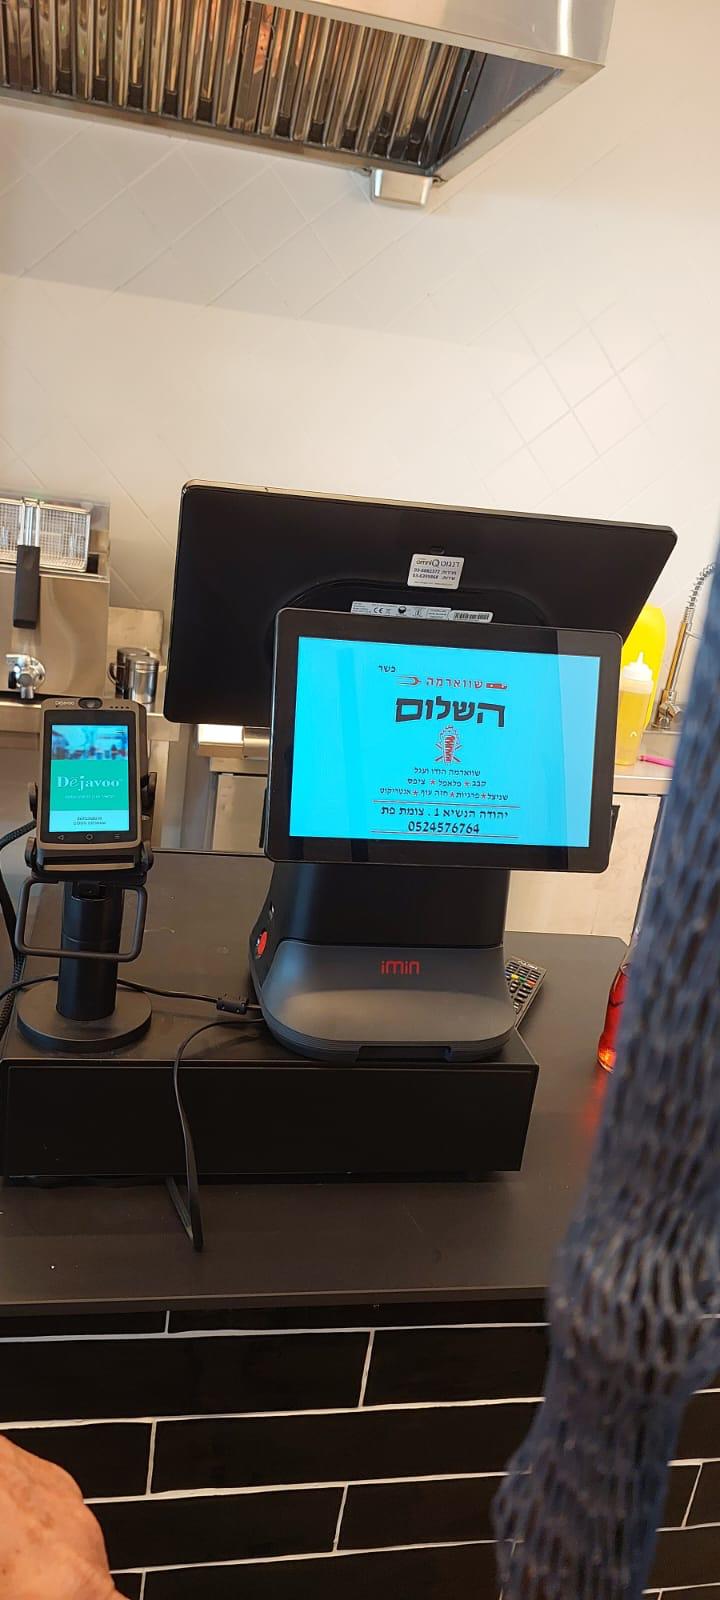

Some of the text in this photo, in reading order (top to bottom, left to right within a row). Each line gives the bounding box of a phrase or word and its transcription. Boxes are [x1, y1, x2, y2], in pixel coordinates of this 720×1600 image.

[378, 665, 396, 673] כשר
[426, 677, 483, 689] שווארמה
[395, 695, 506, 728] השלום
[487, 792, 509, 801] שניצל
[380, 805, 396, 815] פת
[399, 806, 425, 816] צומת
[443, 808, 476, 818] הנשיא
[479, 810, 509, 820] יהודה
[407, 820, 480, 834] 0524576764
